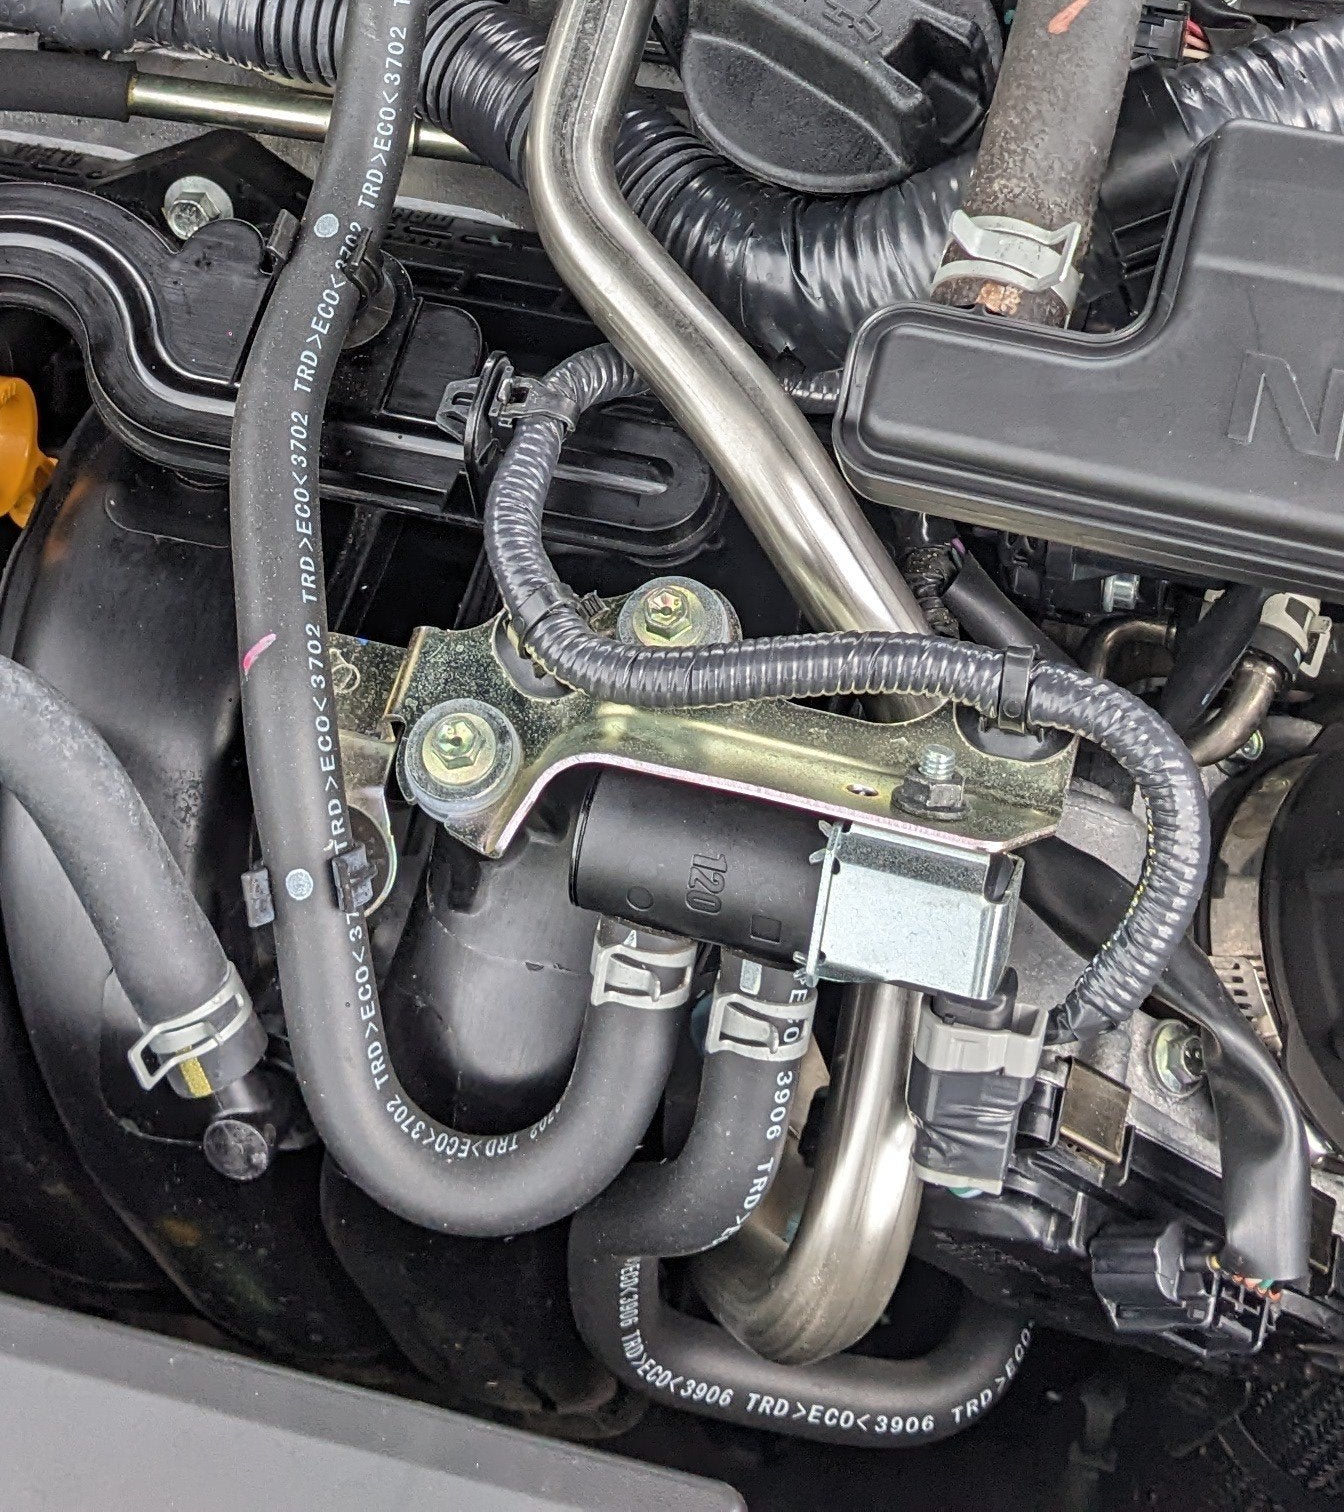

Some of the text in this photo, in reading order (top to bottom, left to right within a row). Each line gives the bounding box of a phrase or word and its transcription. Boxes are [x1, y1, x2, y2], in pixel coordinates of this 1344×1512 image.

[357, 26, 407, 210] TRD>ECO<3702
[290, 410, 319, 604] TRD>ECO<3702
[685, 853, 728, 915] 120
[345, 911, 390, 1091] TRD>ECO<37
